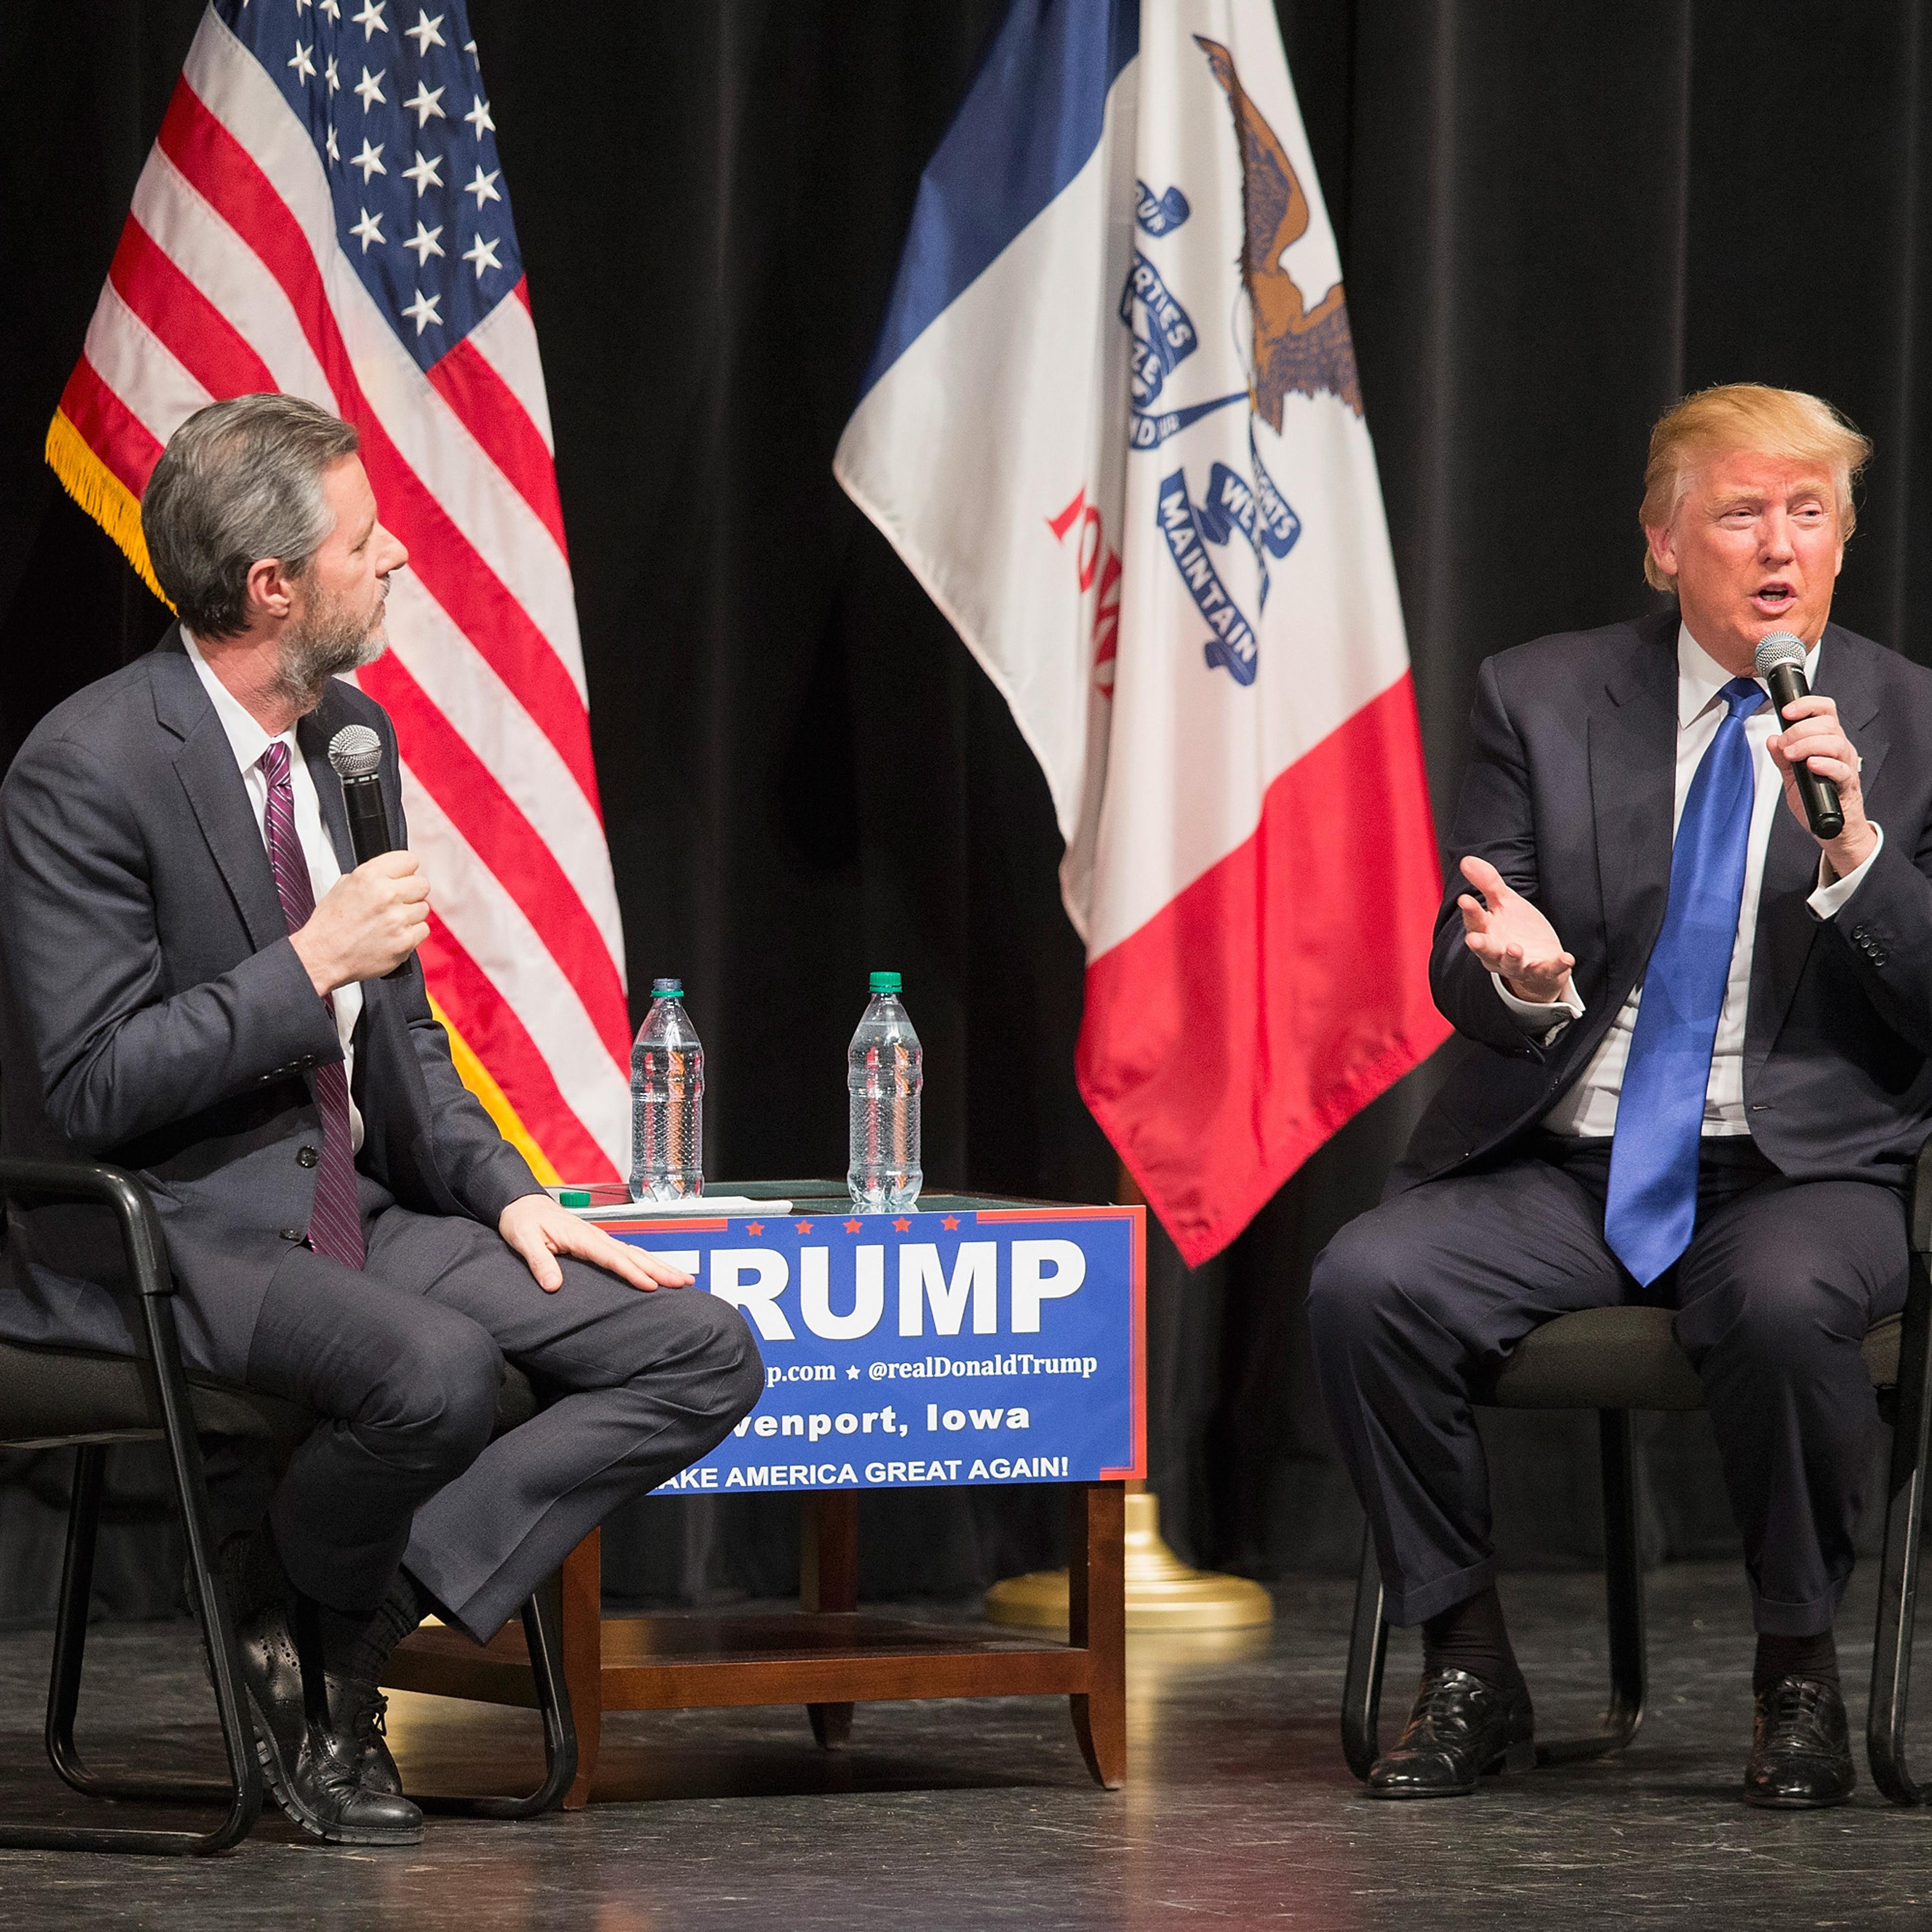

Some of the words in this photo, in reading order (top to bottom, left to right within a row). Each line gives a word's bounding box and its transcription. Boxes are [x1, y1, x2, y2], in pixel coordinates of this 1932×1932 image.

[1133, 257, 1192, 349] RTIES
[1160, 490, 1257, 663] MAINTAIN
[648, 1239, 1087, 1341] RUMP
[765, 1365, 837, 1389] p.com
[868, 1353, 1098, 1382] @realDonaldTrump
[733, 1405, 909, 1442] venport,
[926, 1403, 1030, 1432] Iowa
[655, 1467, 719, 1490] AKE
[724, 1463, 859, 1488] AMERICA
[864, 1459, 963, 1483] GREAT
[967, 1456, 1069, 1481] AGAIN!
